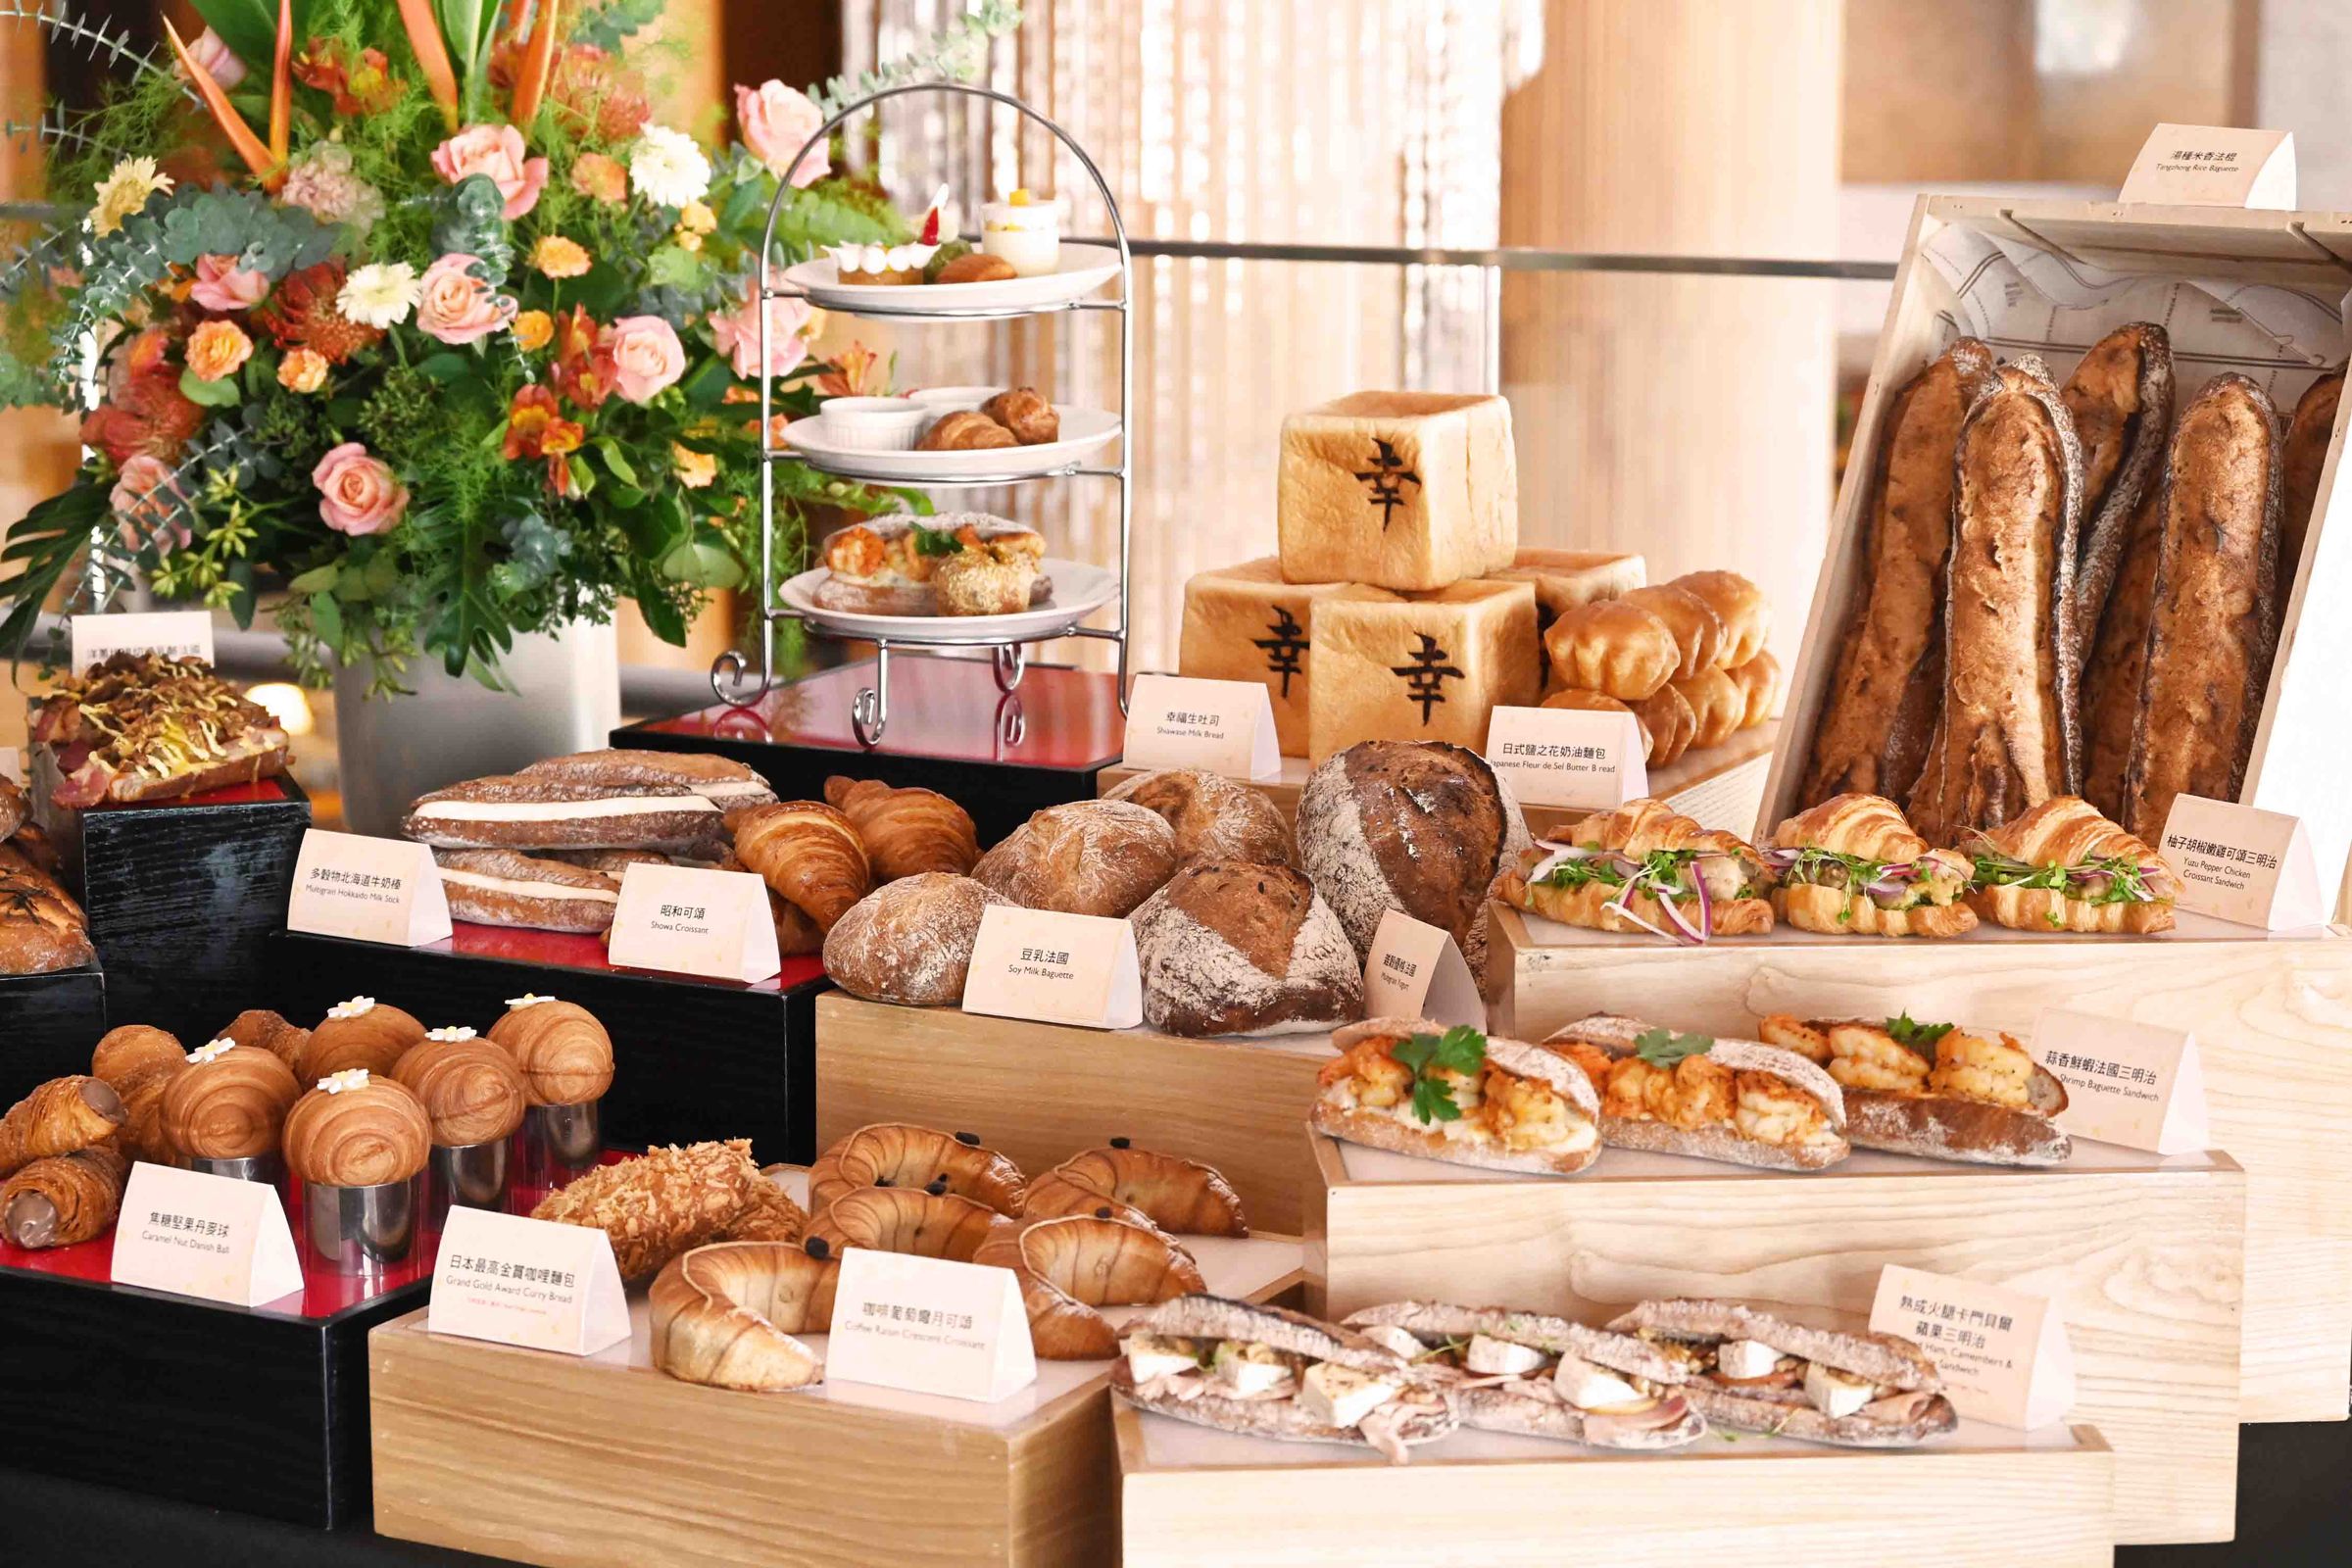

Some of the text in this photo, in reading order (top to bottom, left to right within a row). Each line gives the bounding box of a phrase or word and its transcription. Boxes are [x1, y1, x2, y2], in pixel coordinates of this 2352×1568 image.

[2156, 164, 2190, 172] Tangzhong
[1353, 437, 1422, 532] 幸
[1250, 605, 1310, 699] 幸
[1392, 630, 1465, 726] 幸
[1166, 711, 1220, 726] 幸福生吐司
[1156, 727, 1186, 736] Shiawase
[1203, 730, 1224, 739] Bread
[1502, 743, 1606, 760] 日式鹽之花奶油麵包
[1566, 762, 1589, 771] Butter
[2167, 834, 2278, 869] 柚子胡椒嫩雞可頌三明治
[310, 867, 402, 890] 多穀物北海道牛奶棒
[2183, 857, 2251, 879] Yuzu Pepper Chicken
[2182, 869, 2245, 890] Croissant Sandwich
[306, 884, 400, 904] Multigrain Hokkaido Milk Stick
[661, 905, 706, 920] 昭和可頌
[651, 921, 709, 934] Showa Croissant
[1020, 948, 1069, 964] 豆乳法國
[1007, 964, 1074, 980] Soy Milk Baguette
[2045, 1051, 2157, 1085] 蒜香鮮蝦法國三明治
[2060, 1074, 2159, 1102] Shrimp Baguette Sandwich
[142, 1230, 230, 1254] Caramel Nut Danish Ball
[446, 1275, 573, 1304] Grand Gold Award Curry Bread
[845, 1320, 986, 1350] Coffee Raisin Crescent Croissant
